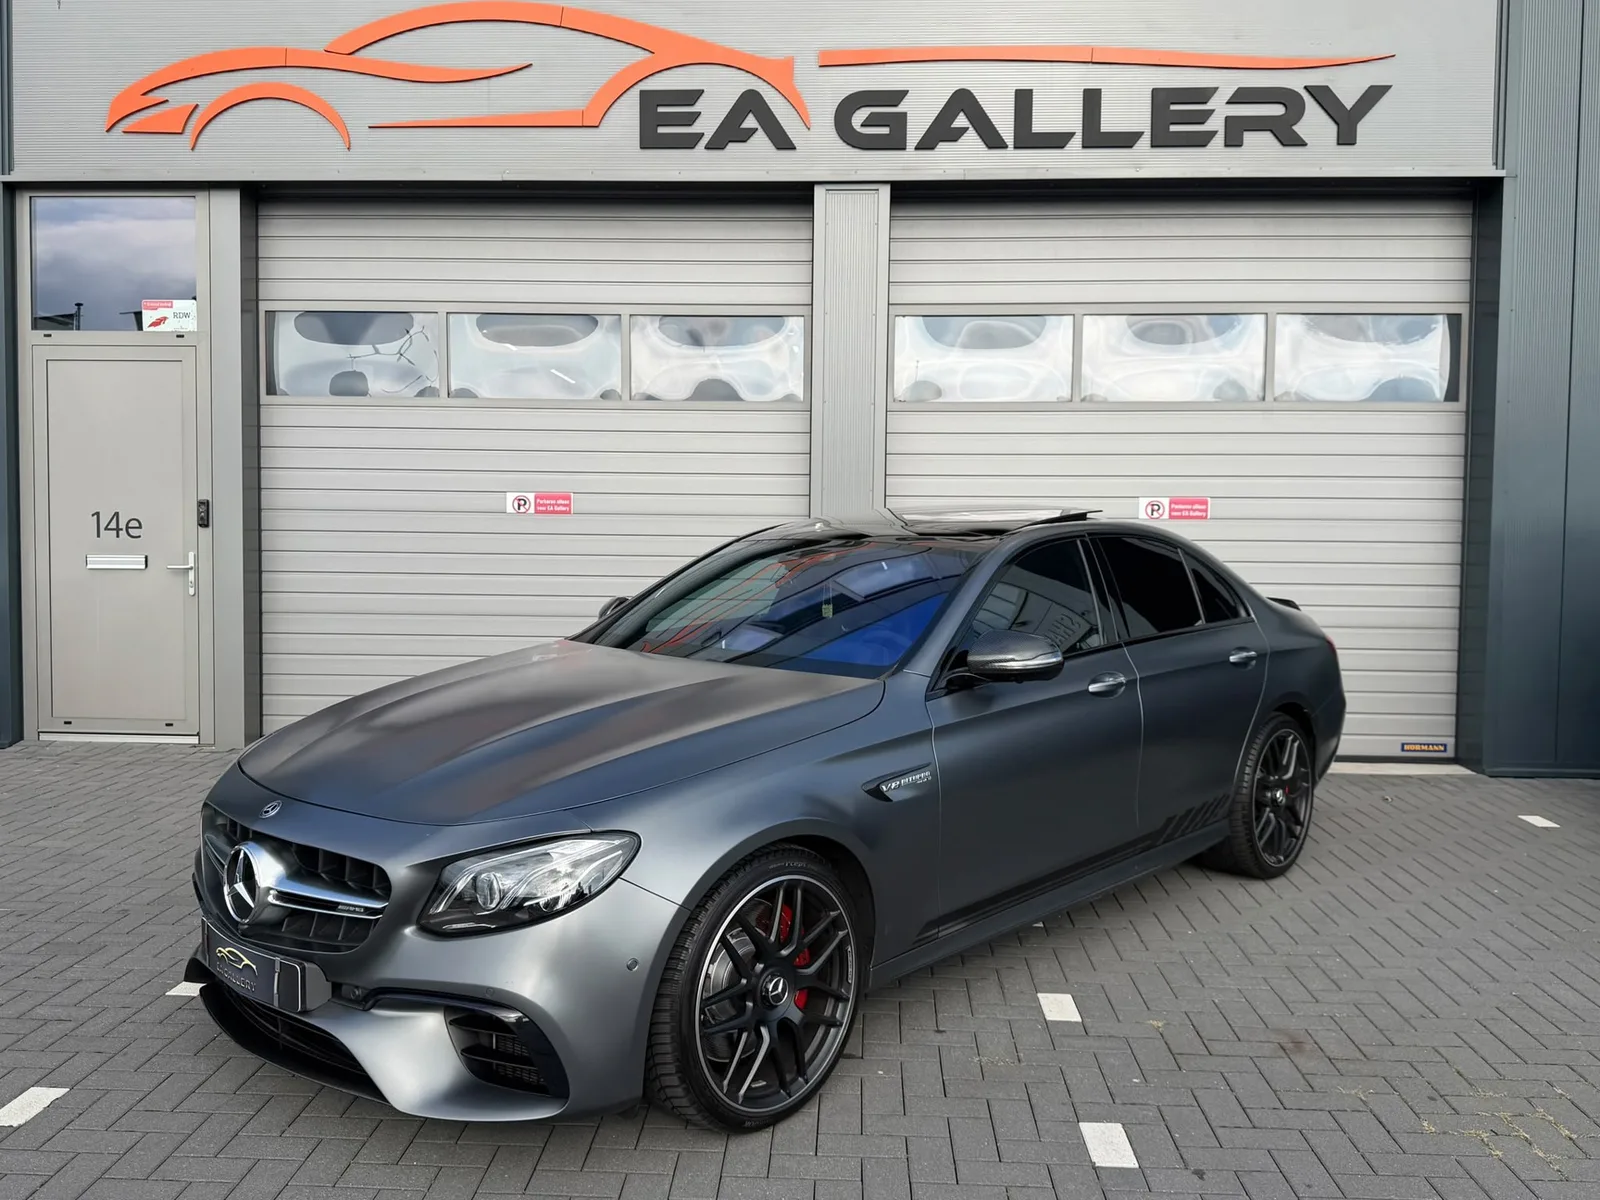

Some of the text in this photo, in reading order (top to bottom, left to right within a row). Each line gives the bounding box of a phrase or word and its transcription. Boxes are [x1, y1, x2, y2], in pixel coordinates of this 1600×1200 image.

[639, 85, 1393, 151] EA GALLERY
[172, 311, 191, 319] RDW
[91, 511, 143, 539] 14e
[881, 780, 900, 792] V8
